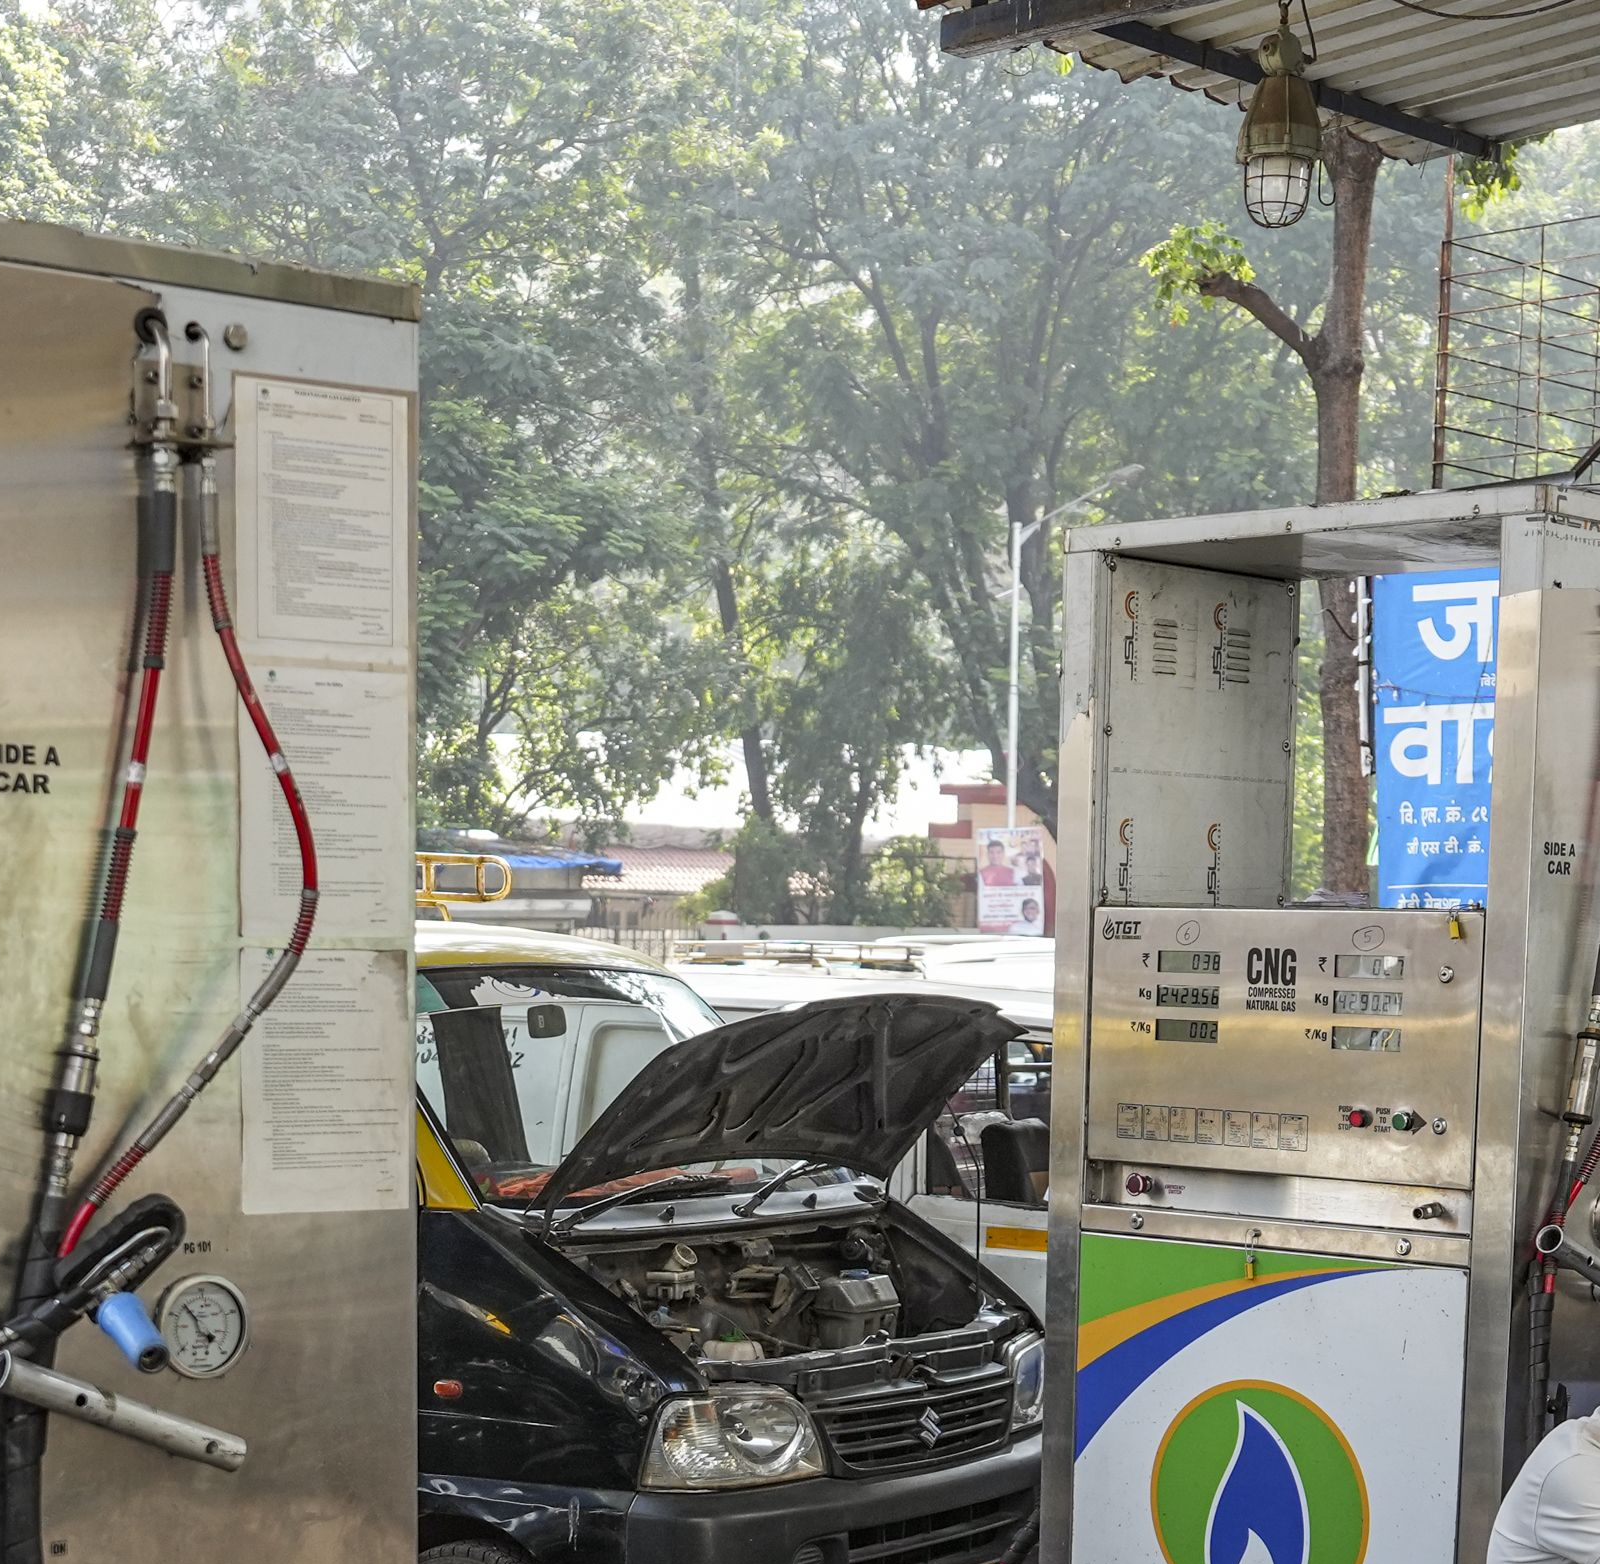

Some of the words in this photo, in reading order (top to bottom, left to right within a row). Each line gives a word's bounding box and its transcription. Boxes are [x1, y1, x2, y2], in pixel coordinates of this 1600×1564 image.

[1412, 579, 1500, 663] ज
[1383, 702, 1495, 785] वा
[44, 746, 61, 767] A
[1543, 841, 1567, 858] SIDE
[1568, 843, 1576, 858] A
[1547, 860, 1571, 876] CAR
[1114, 920, 1142, 935] TGT
[1191, 953, 1222, 972] 038
[1246, 947, 1297, 987] CNG
[1138, 987, 1152, 1001] Kg
[1247, 986, 1296, 999] COMPRESSED
[1314, 993, 1329, 1007] Kg
[1245, 999, 1279, 1012] NATURAL
[1280, 1000, 1297, 1013] GAS
[1189, 1021, 1219, 1040] 002
[1338, 1105, 1354, 1113] PUSH
[1375, 1107, 1391, 1115] PUSH
[1379, 1116, 1387, 1124] TO
[1373, 1125, 1392, 1133] START
[183, 1242, 196, 1255] PG
[197, 1240, 212, 1254] 101
[52, 1542, 67, 1555] ON
